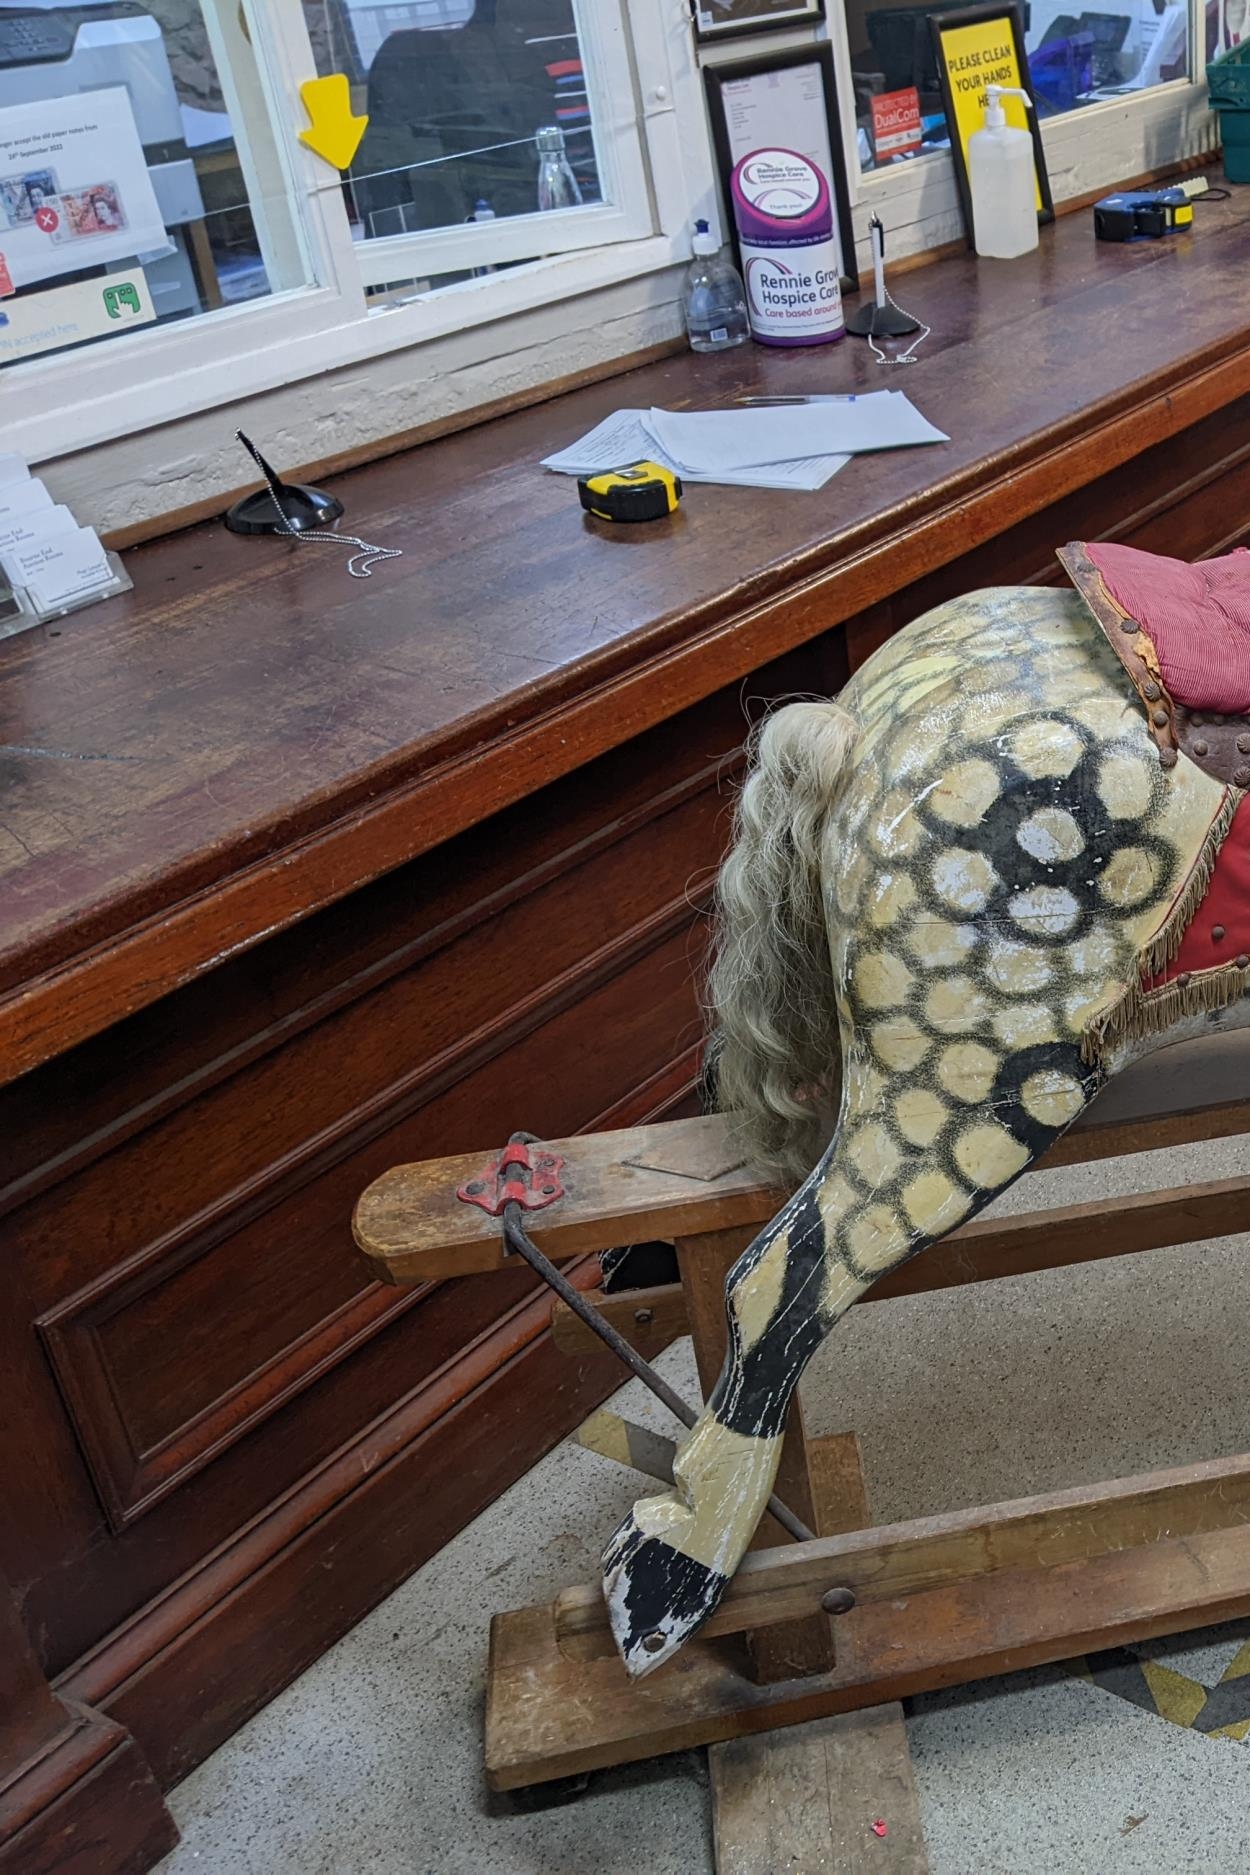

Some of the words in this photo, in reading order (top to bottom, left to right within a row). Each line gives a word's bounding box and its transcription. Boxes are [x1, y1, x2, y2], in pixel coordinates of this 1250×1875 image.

[948, 51, 983, 74] PLEASE
[982, 44, 1011, 64] CLEAN
[955, 74, 983, 93] YOUR
[982, 65, 1012, 85] HANDS
[874, 108, 920, 129] DualCom
[760, 272, 812, 289] Rennie
[762, 290, 817, 308] Hospice
[819, 284, 839, 300] Care
[764, 307, 784, 318] Care
[785, 307, 813, 318] based
